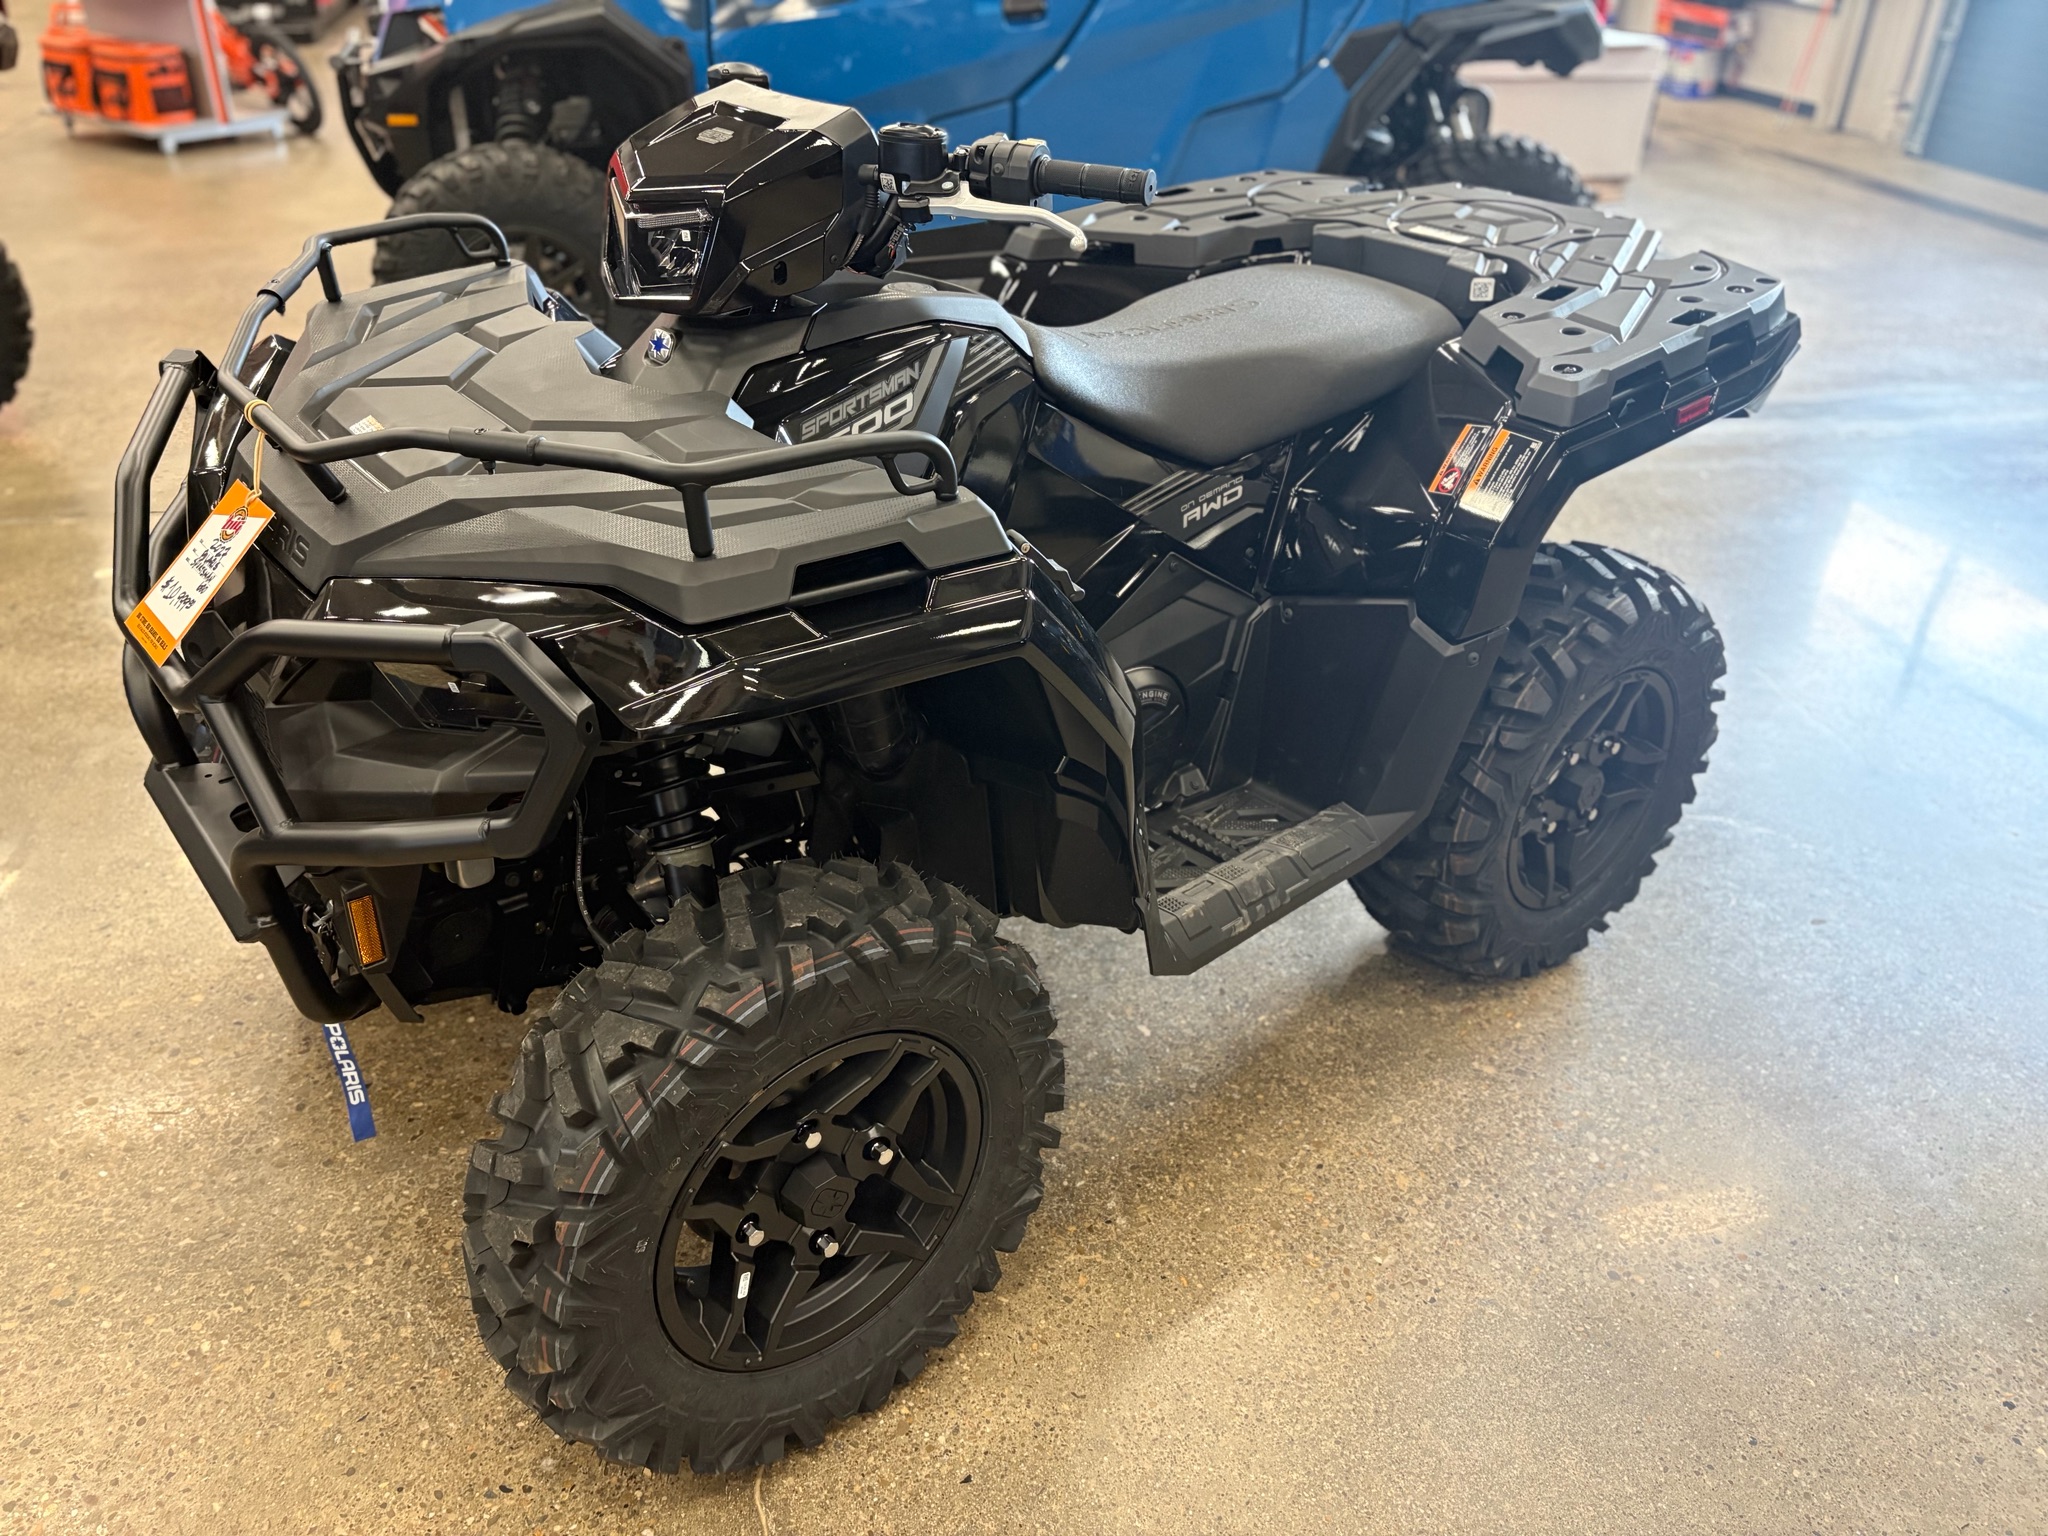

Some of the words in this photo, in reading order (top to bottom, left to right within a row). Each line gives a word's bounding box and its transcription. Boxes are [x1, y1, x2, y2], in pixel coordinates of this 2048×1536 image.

[802, 361, 922, 440] SPORTSMAN
[1477, 447, 1499, 478] WARNING
[1180, 500, 1196, 512] ON
[1198, 475, 1244, 503] DEMAND
[1182, 484, 1244, 528] AWD
[1139, 690, 1168, 701] NGINE
[324, 1023, 366, 1106] POLARIS
